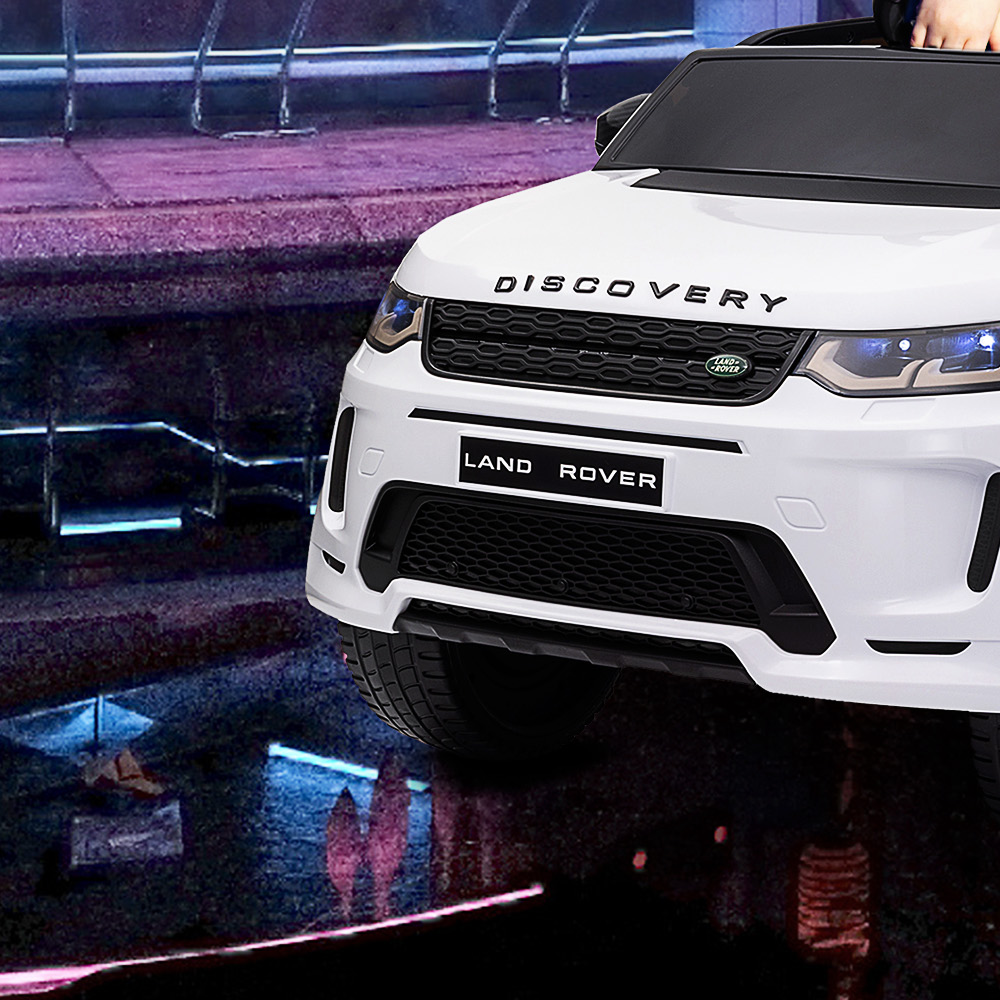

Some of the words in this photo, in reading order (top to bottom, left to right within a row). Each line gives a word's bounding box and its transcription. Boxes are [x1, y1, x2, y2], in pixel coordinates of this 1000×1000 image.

[493, 274, 788, 312] DISCOVERY
[464, 452, 532, 474] LAND
[559, 463, 657, 489] ROVER
